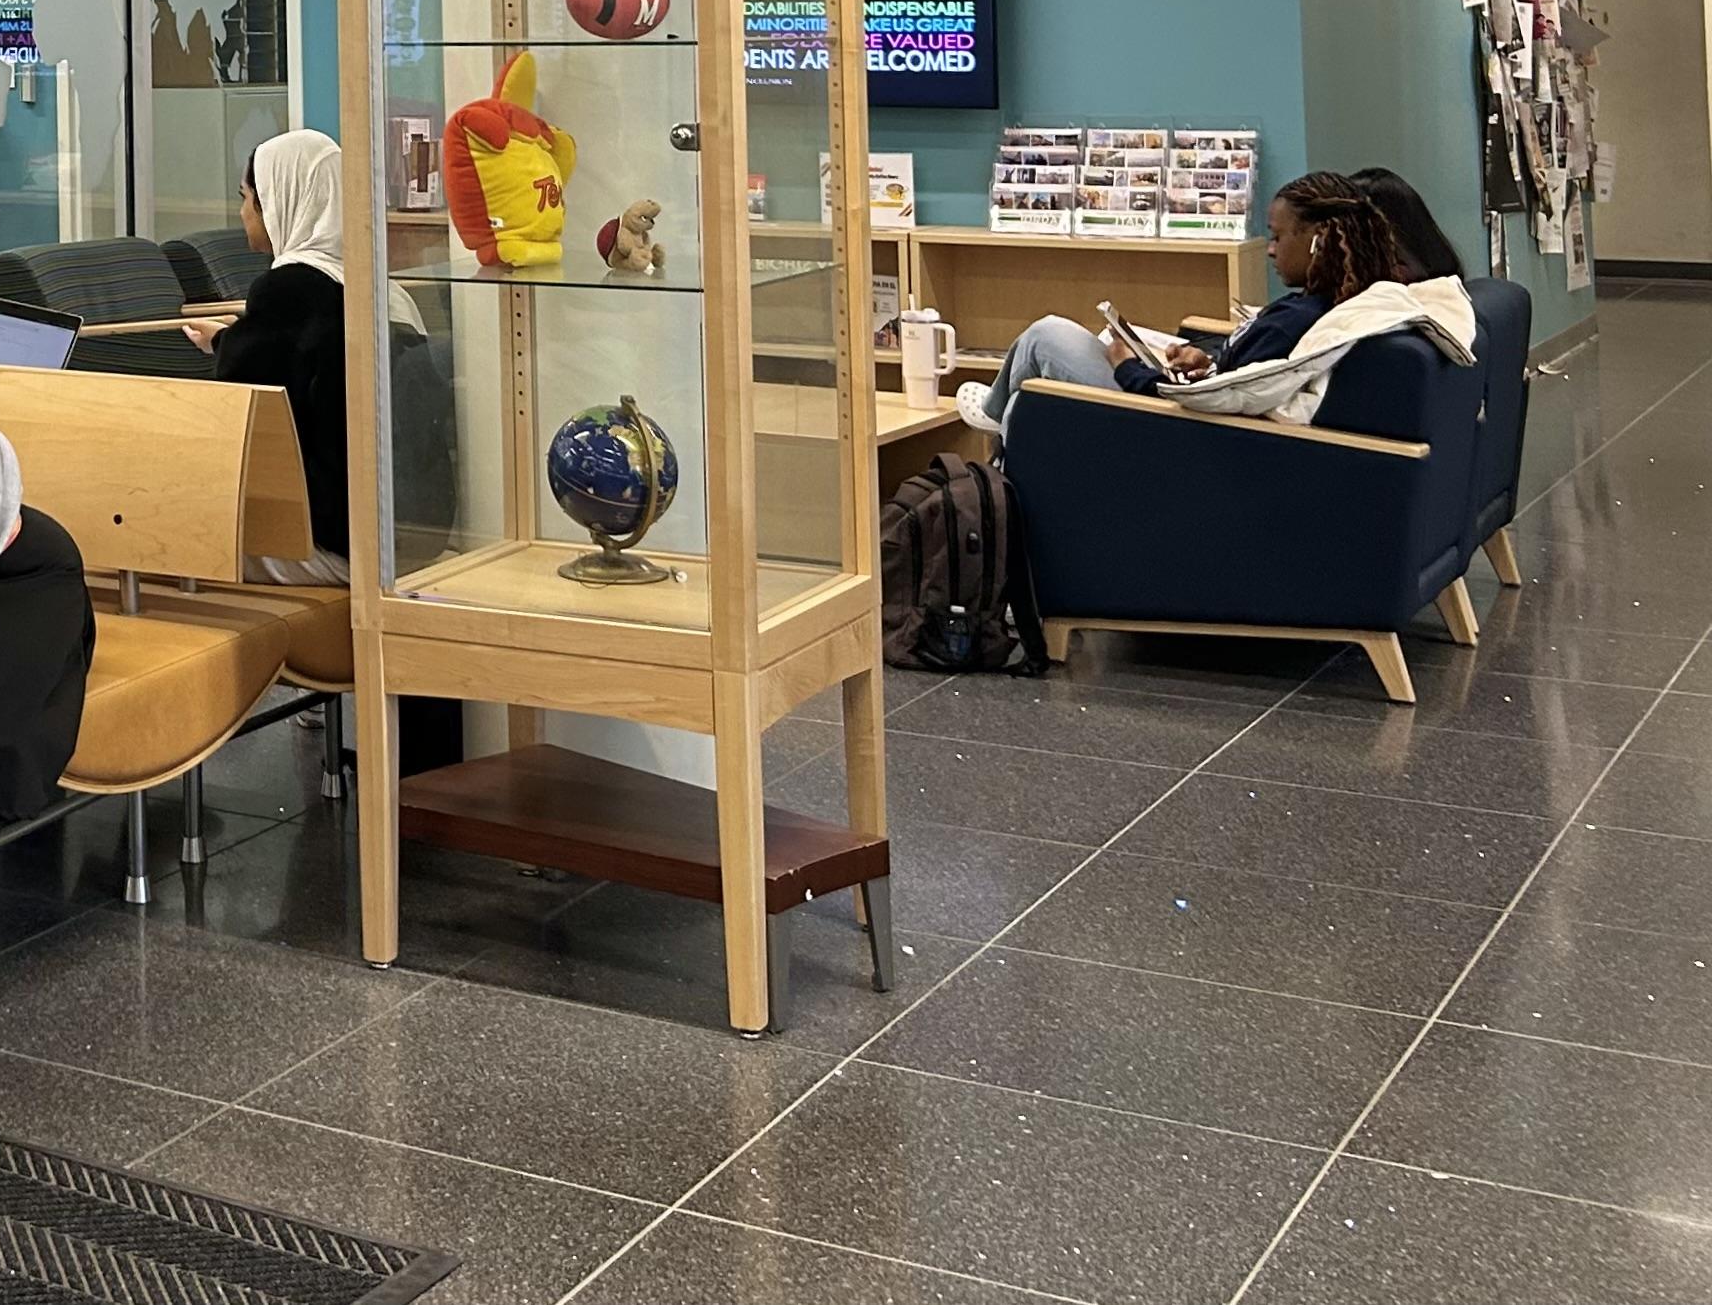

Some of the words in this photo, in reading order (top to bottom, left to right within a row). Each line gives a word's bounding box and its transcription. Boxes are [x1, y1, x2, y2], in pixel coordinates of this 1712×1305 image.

[744, 1, 826, 16] DISABILITIES
[864, 1, 976, 16] NDISPENSABLE
[746, 18, 828, 31] MINORITIE
[893, 18, 915, 32] US
[916, 18, 977, 32] GREAT
[886, 33, 975, 49] VALUED
[800, 49, 830, 70] AR
[866, 49, 977, 72] ELCOMED
